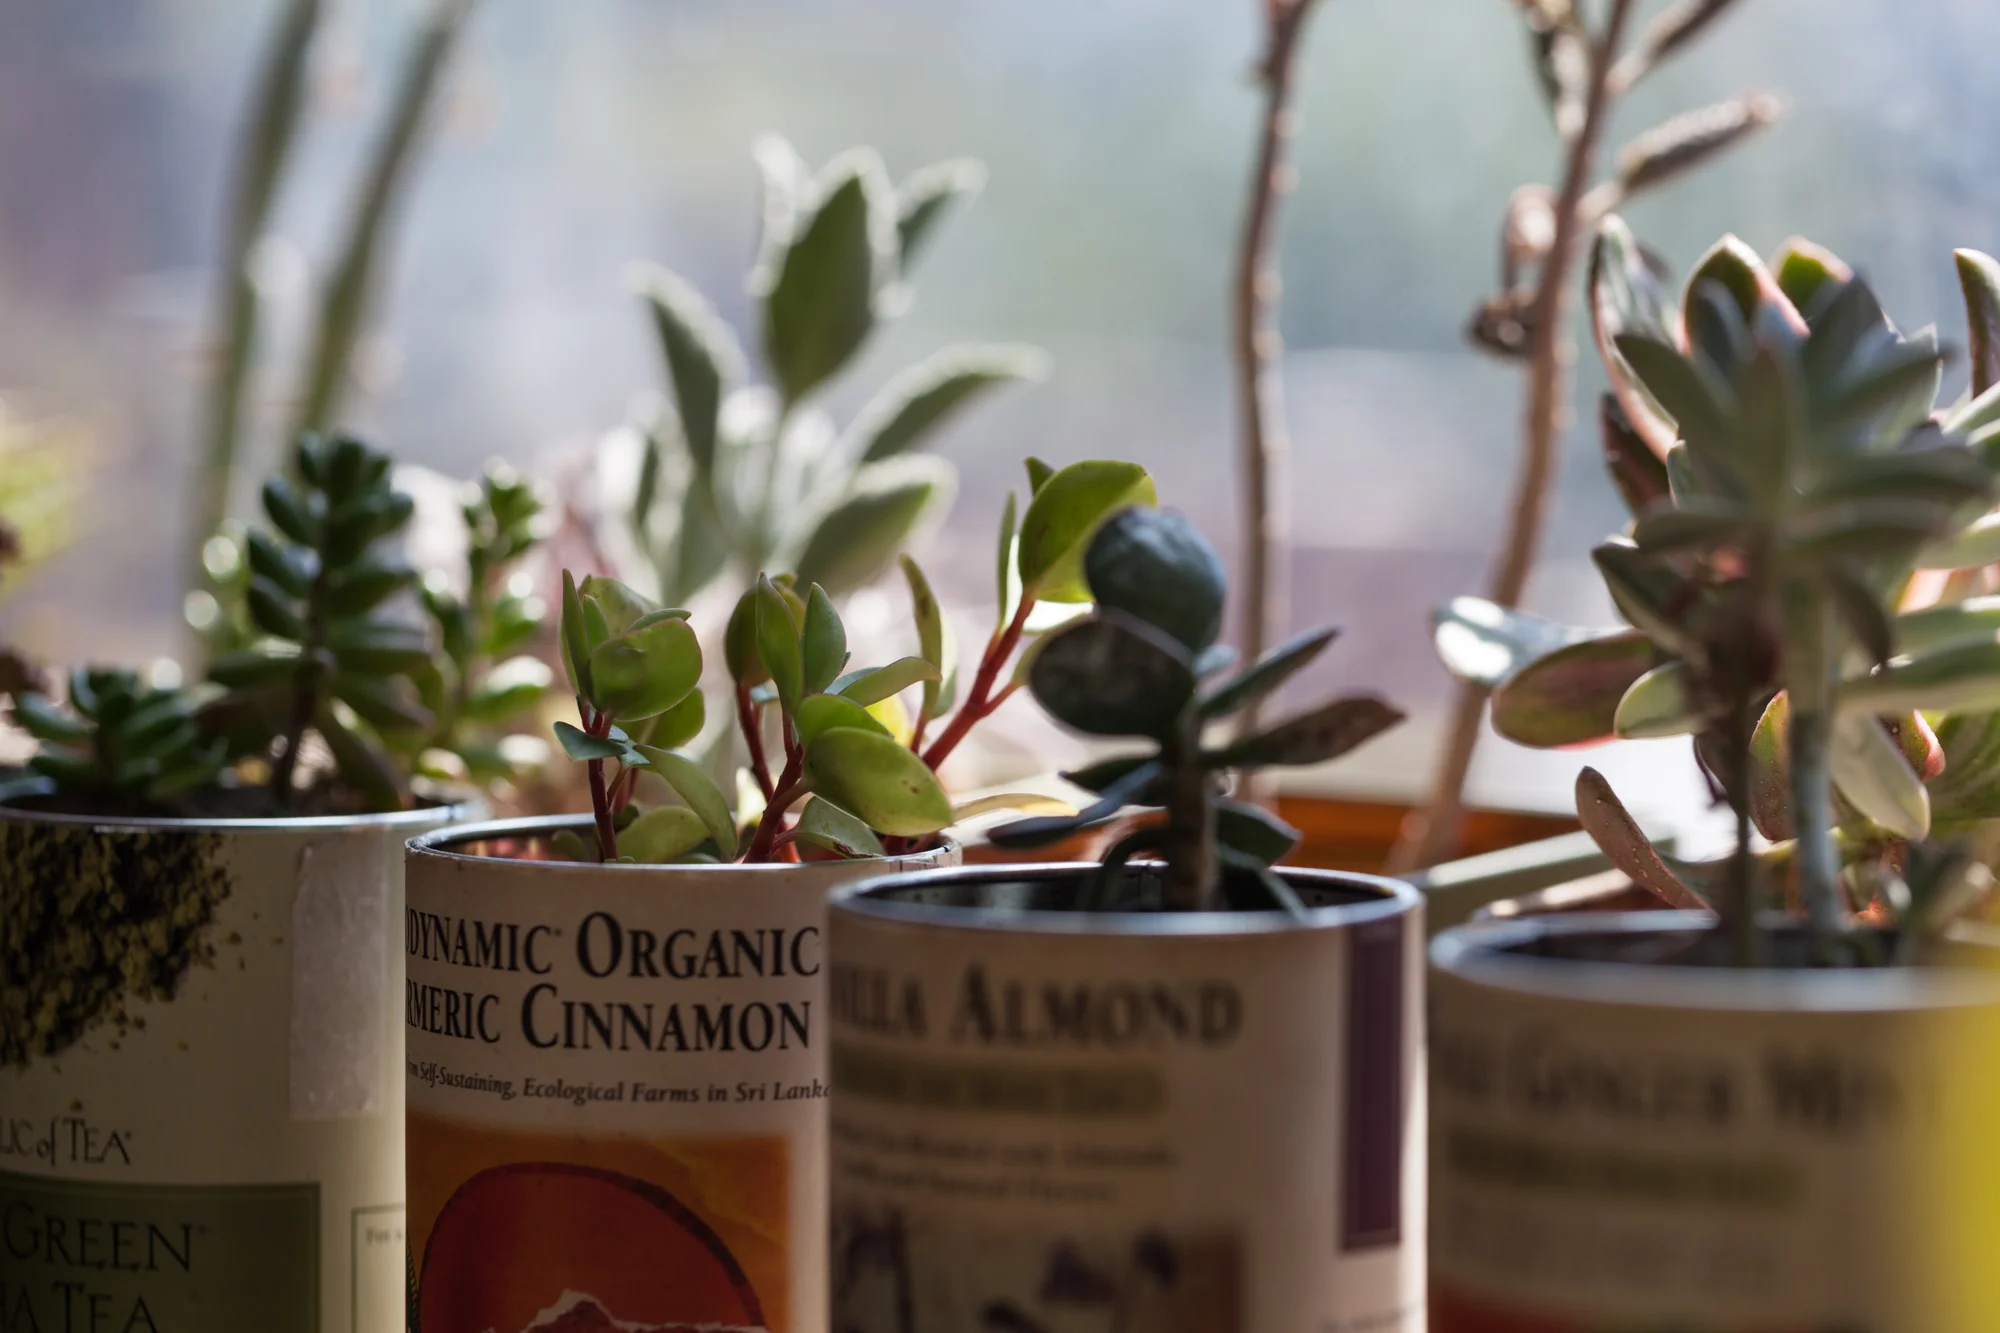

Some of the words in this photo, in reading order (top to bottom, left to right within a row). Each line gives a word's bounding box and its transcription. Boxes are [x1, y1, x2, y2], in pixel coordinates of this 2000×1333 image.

[576, 911, 820, 979] ORGANIC
[521, 983, 811, 1053] CINNAMON
[950, 960, 1244, 1046] ALMOND
[420, 1061, 517, 1101] Self-Sustaining,
[523, 1078, 623, 1105] Ecological
[632, 1081, 699, 1103] Farms
[707, 1083, 728, 1103] in
[734, 1081, 766, 1103] Sri
[36, 1116, 59, 1166] of
[62, 1116, 131, 1165] TEA
[4, 1200, 193, 1272] GREEN
[52, 1279, 158, 1333] TEA
